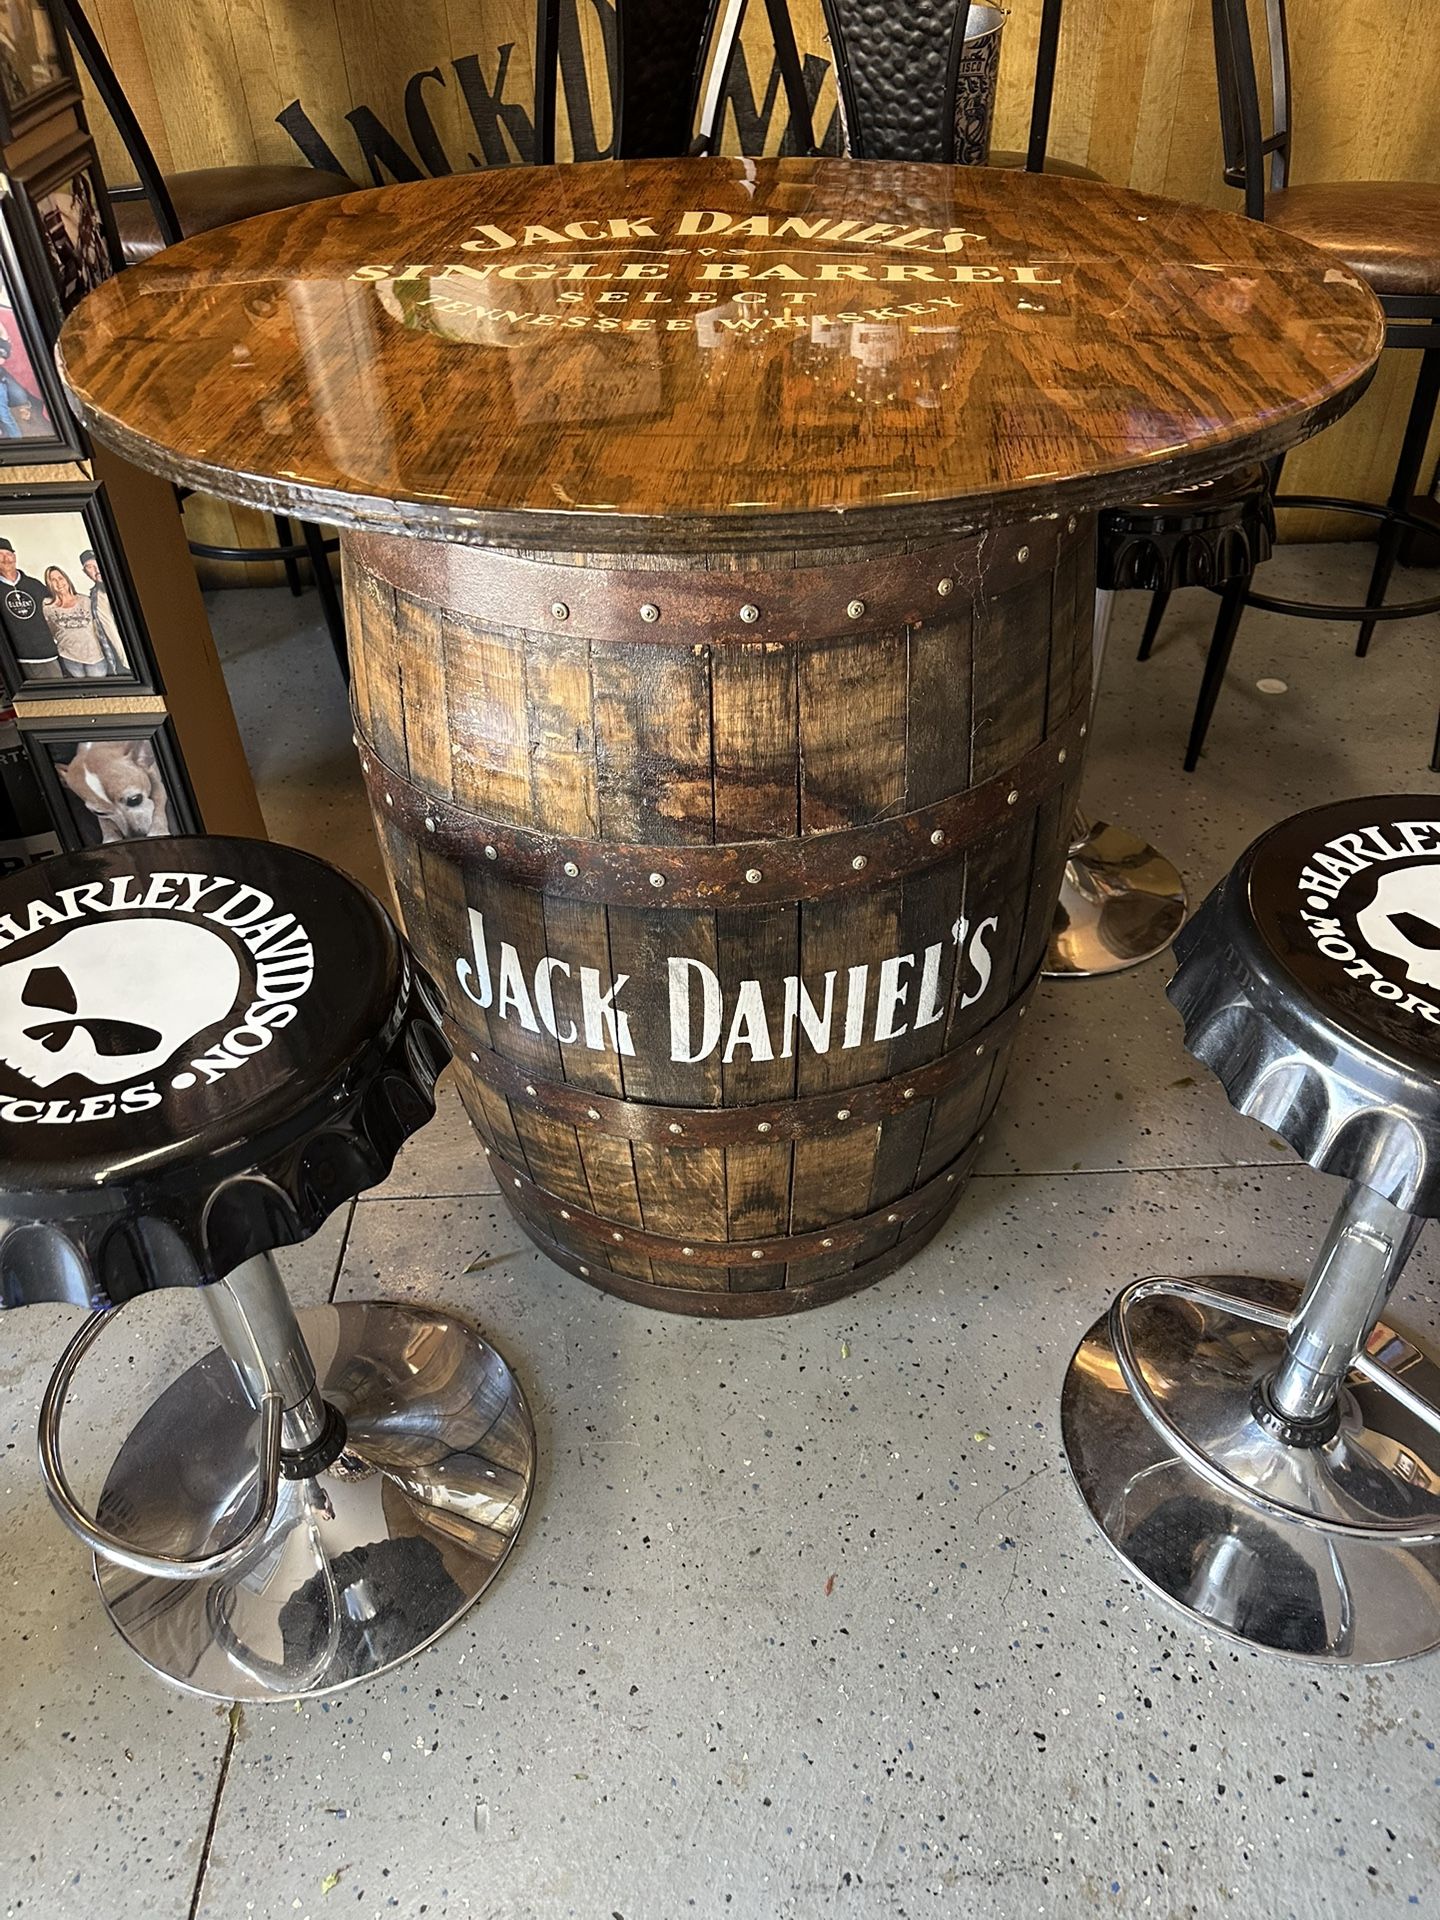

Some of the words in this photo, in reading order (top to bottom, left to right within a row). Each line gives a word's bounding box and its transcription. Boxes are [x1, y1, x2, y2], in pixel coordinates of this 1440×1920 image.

[460, 216, 659, 251] JACK
[675, 211, 987, 254] DANIEL'S
[347, 263, 669, 281] SINGLE
[695, 263, 1062, 284] BARREL
[417, 294, 693, 331] TENNESSEE
[719, 296, 964, 330] WHISKEY
[556, 291, 818, 304] SELECT
[1298, 821, 1440, 899] HARLE
[0, 872, 235, 950] HARLEY
[190, 884, 315, 1085] DAVIDSON
[455, 907, 636, 1057] JACK
[668, 915, 999, 1064] DANIEL'S
[0, 1081, 163, 1124] CLES
